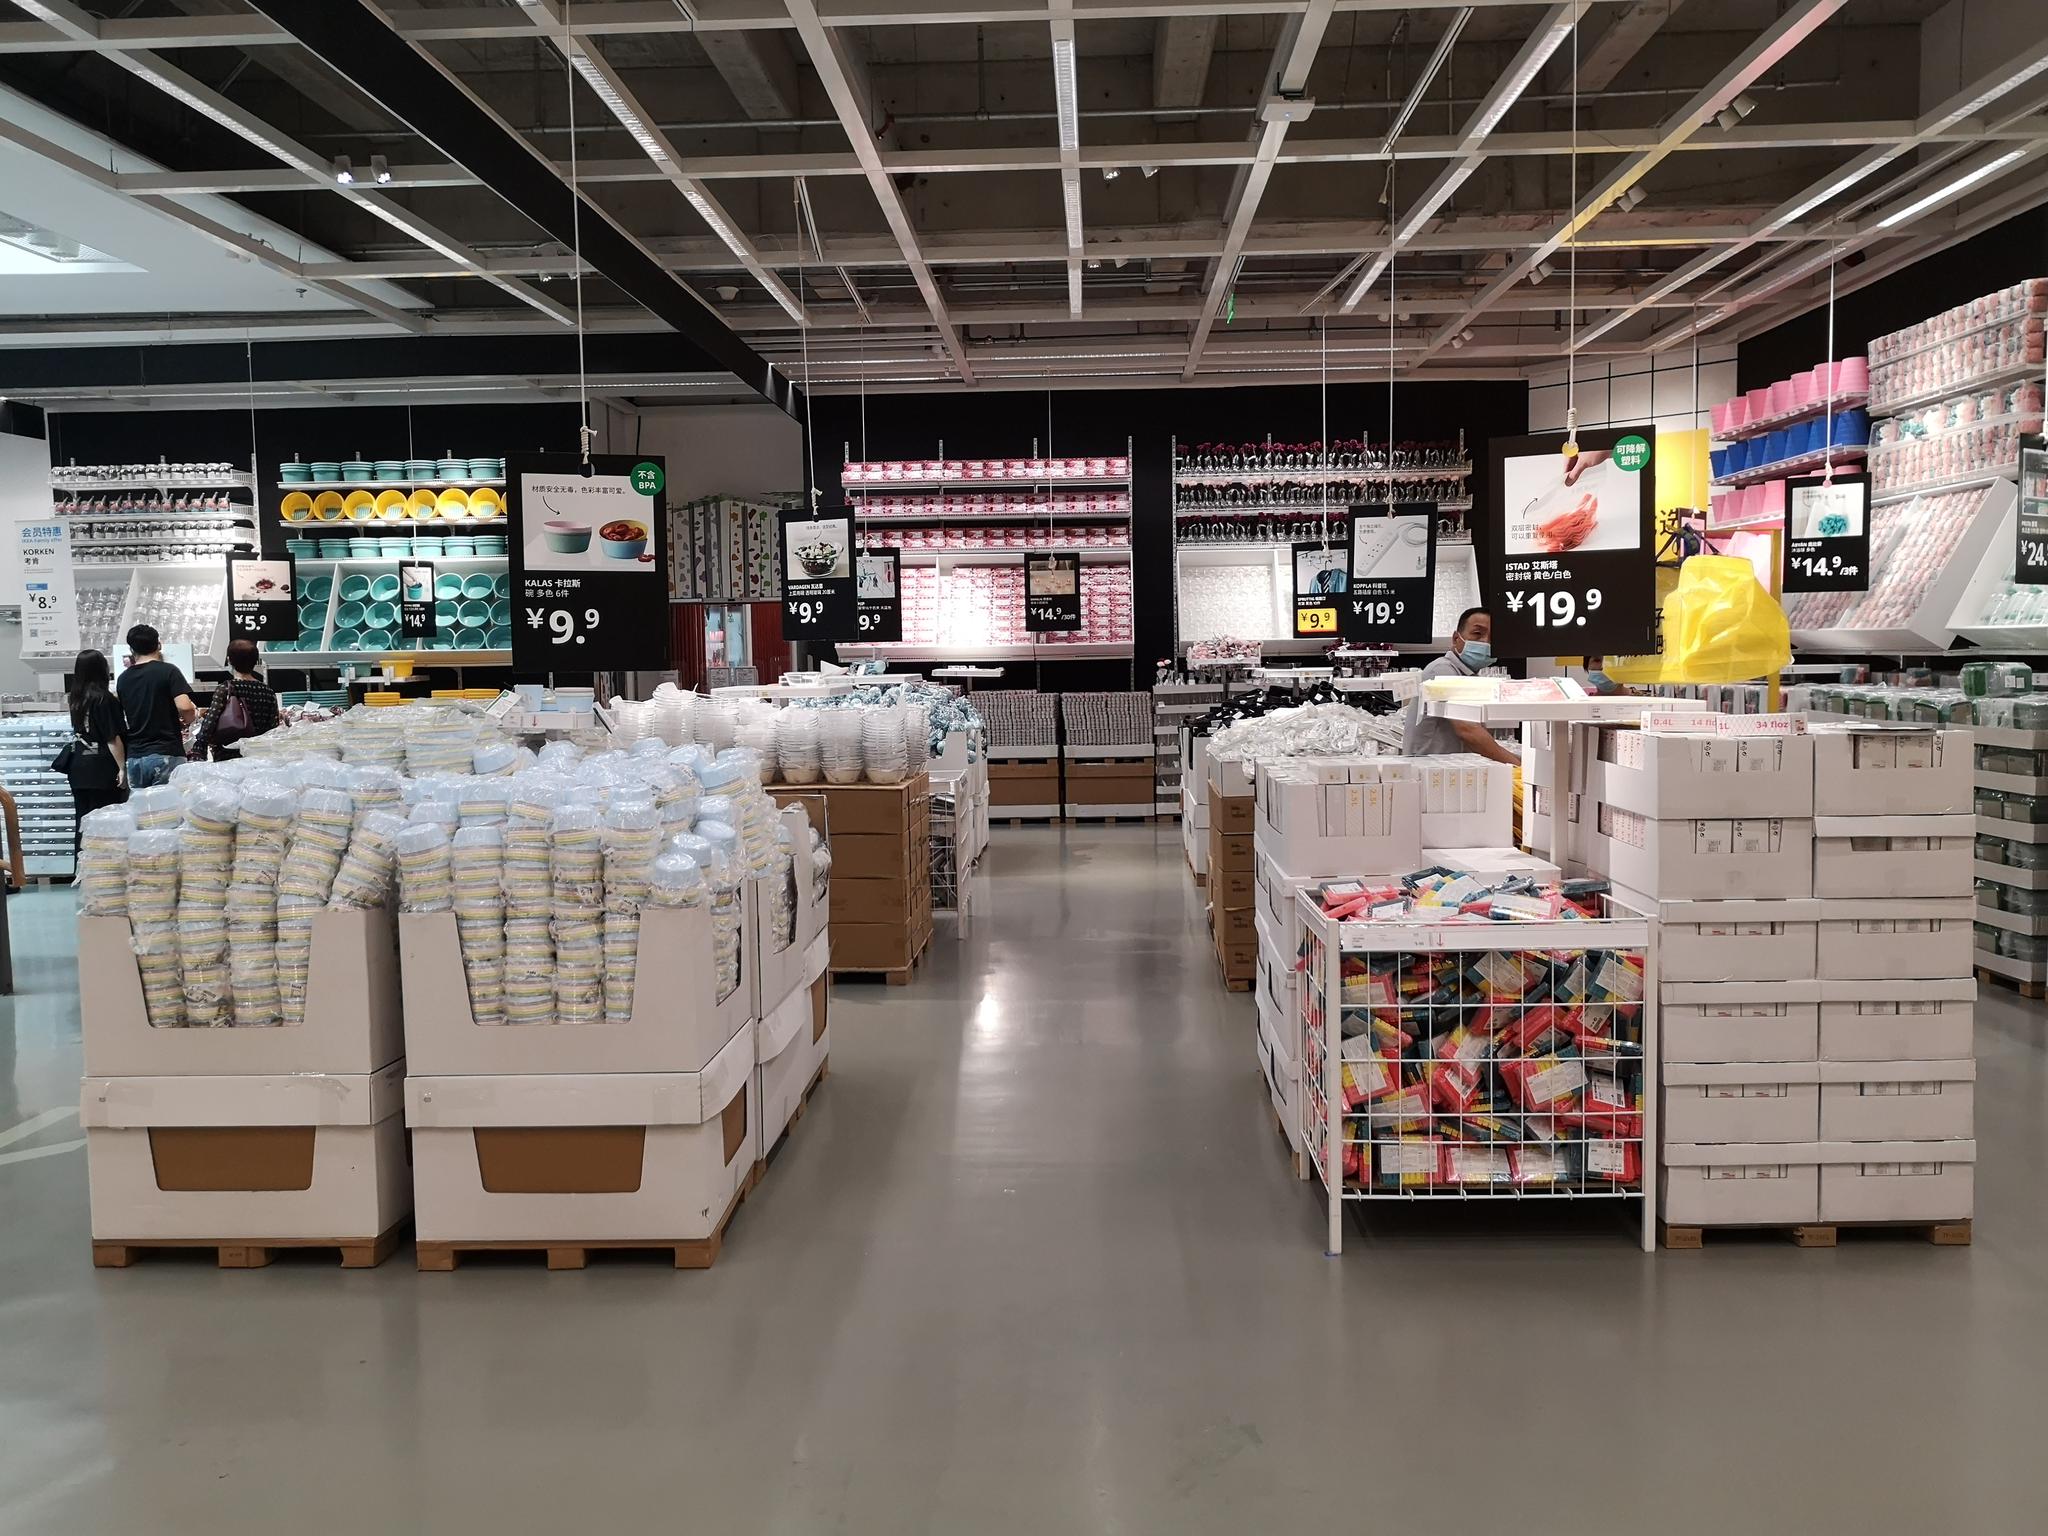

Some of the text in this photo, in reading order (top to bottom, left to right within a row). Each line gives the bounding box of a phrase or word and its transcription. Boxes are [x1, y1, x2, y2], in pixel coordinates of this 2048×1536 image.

[1616, 443, 1646, 455] 可降解
[1620, 456, 1641, 466] 塑料
[637, 470, 656, 480] 不含
[638, 481, 656, 490] BPA
[22, 526, 62, 538] 会员特惠
[23, 548, 55, 556] KORKEN
[2021, 540, 2048, 566] ¥24.
[1505, 560, 1558, 571] ISTAD 艾斯塔
[1791, 555, 1842, 577] ¥14.9
[1505, 570, 1572, 581] 密封袋 黄色/白色
[524, 579, 581, 588] KALAS 卡拉斯
[525, 588, 570, 598] 碗 多色 6件
[29, 593, 57, 609] ¥8.9
[788, 601, 824, 624] ¥9.9
[1031, 607, 1062, 620] ¥14.9
[1352, 601, 1405, 625] ¥19.9
[1505, 588, 1602, 627] ¥19.9
[235, 614, 267, 631] ¥5.9
[404, 613, 426, 628] ¥14.9
[525, 607, 600, 645] ¥9.9
[859, 614, 881, 631] 9.9
[1301, 612, 1330, 629] ¥9.9
[1691, 719, 1703, 727] 14
[1719, 722, 1729, 730] 1L
[1756, 721, 1768, 729] 34
